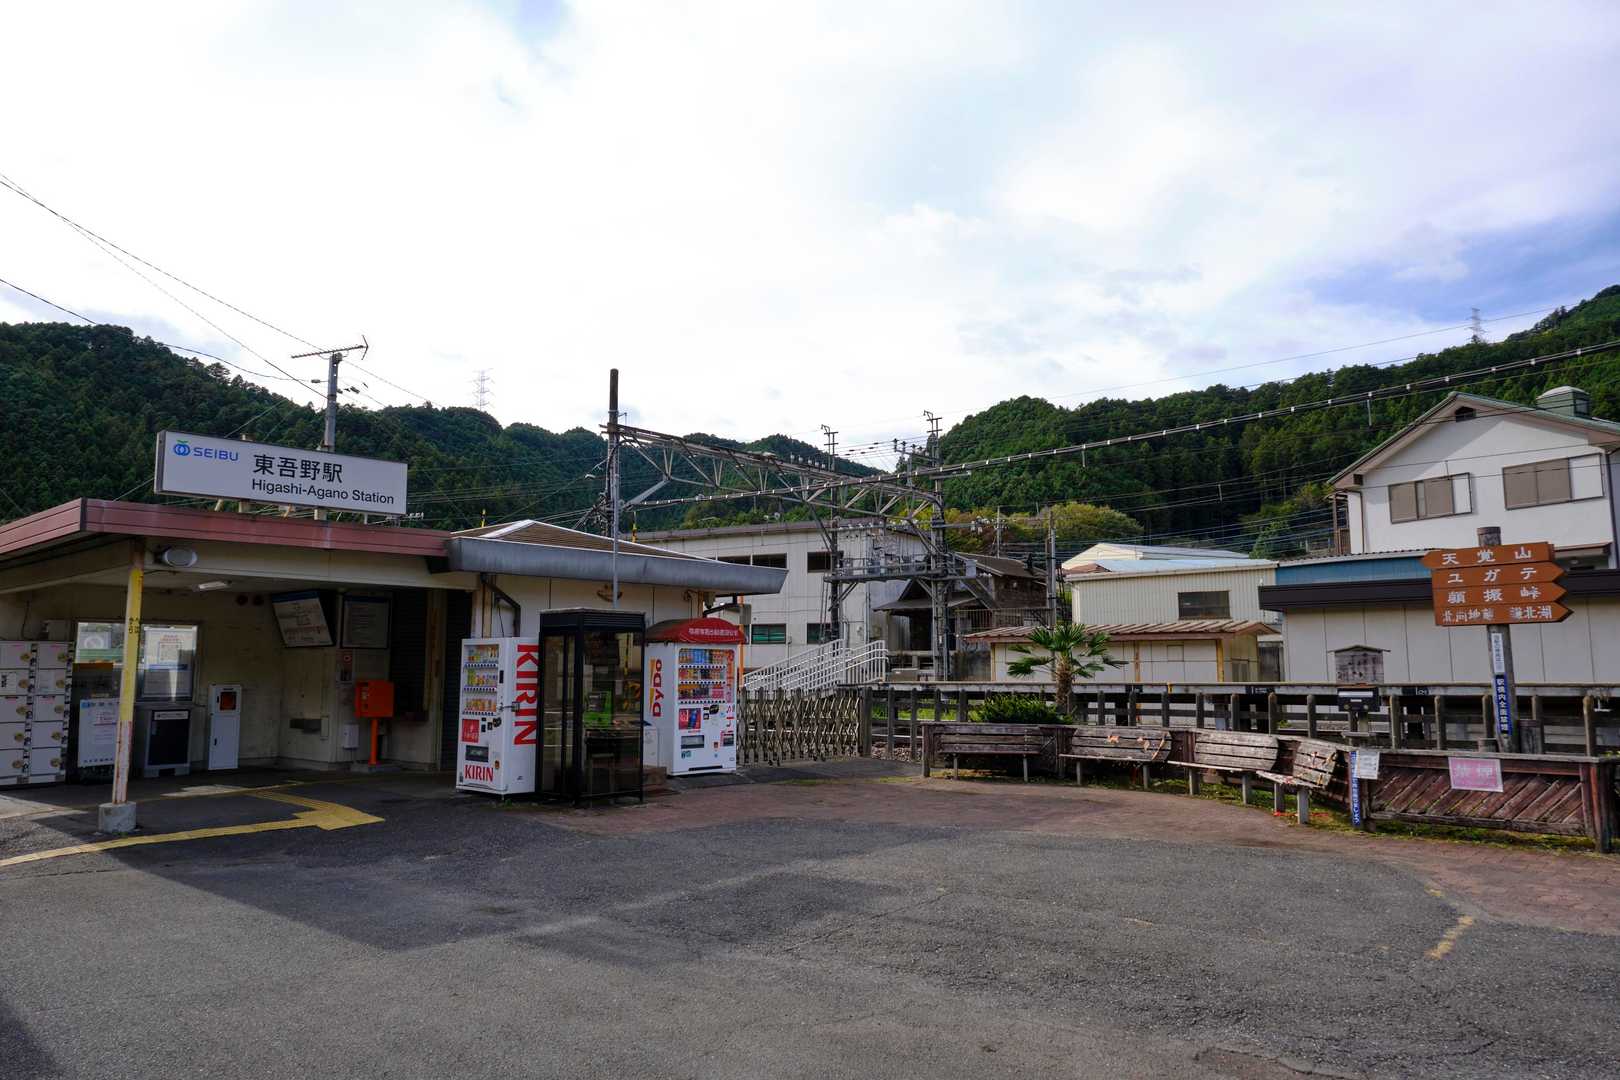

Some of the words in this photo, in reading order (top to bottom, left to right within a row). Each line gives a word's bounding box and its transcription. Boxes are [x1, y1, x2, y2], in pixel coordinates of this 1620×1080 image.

[193, 446, 239, 461] SEIBU
[253, 454, 342, 483] 東吾野駅
[252, 478, 349, 501] Higashi-Agano
[352, 489, 394, 505] Station
[1447, 567, 1537, 584] ユガテ
[514, 644, 539, 745] KIRIN
[464, 764, 494, 782] KIRIN
